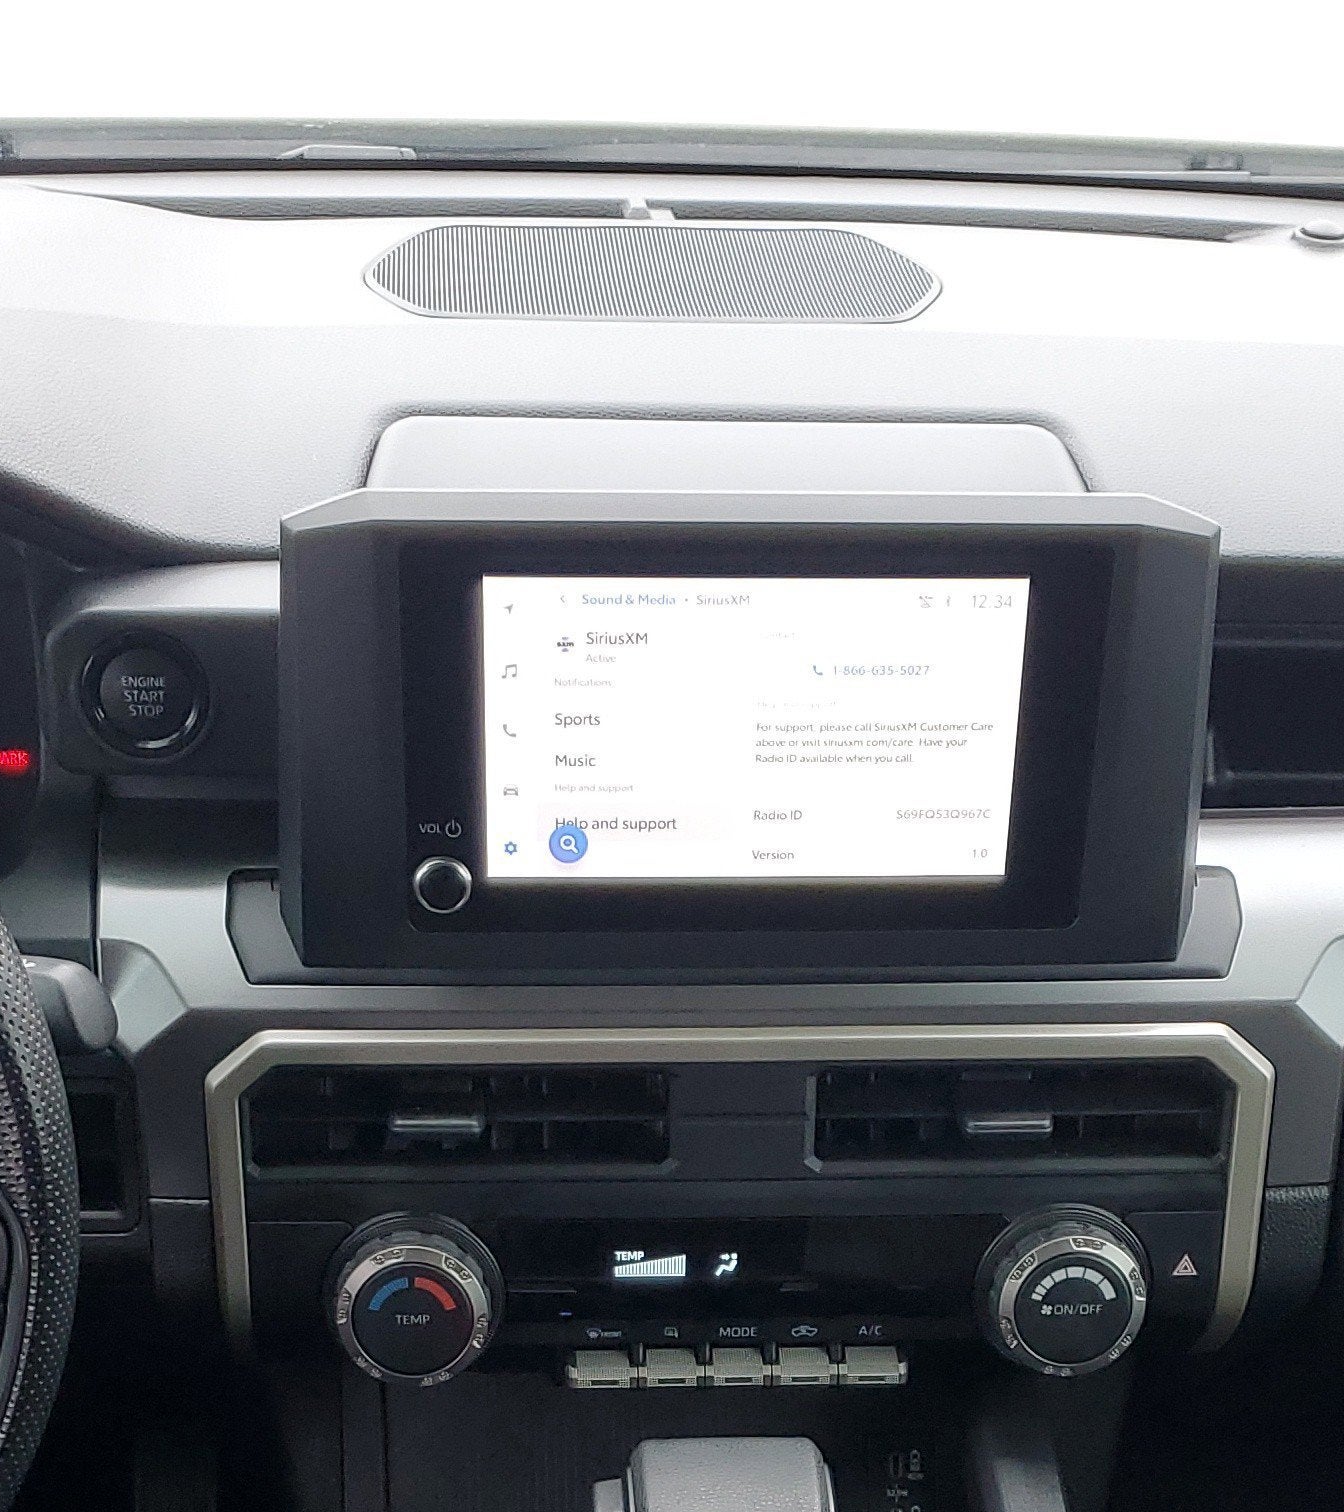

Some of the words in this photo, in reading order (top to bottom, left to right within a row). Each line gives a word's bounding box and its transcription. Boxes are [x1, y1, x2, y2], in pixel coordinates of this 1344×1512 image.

[582, 594, 622, 605] Sound
[625, 594, 634, 605] &
[638, 594, 676, 605] Media
[696, 594, 750, 606] SiriusXM
[586, 632, 648, 645] SiriusXM
[586, 653, 617, 662] Active
[833, 665, 931, 676] 1-866-635-5027
[121, 675, 166, 687] ENGINE
[554, 678, 613, 687] Notifications
[123, 690, 165, 702] START
[128, 704, 164, 717] STOP
[554, 713, 601, 728] Sports
[757, 723, 772, 732] For
[820, 723, 852, 734] please
[855, 722, 872, 732] call
[874, 723, 917, 732] SiriusXM
[920, 722, 968, 732] Customer
[971, 722, 994, 732] Care
[756, 738, 786, 747] above
[919, 738, 943, 747] Have
[945, 739, 968, 749] your
[555, 754, 596, 767] Music
[756, 754, 784, 763] Radio
[786, 754, 797, 763] ID
[800, 754, 843, 763] available
[846, 754, 872, 763] when
[874, 756, 893, 765] you
[554, 784, 576, 793] Help
[578, 784, 596, 792] and
[598, 785, 634, 794] support
[753, 809, 787, 820] Radio
[790, 809, 803, 820] ID
[592, 818, 618, 830] and
[622, 818, 677, 832] support
[752, 850, 795, 860] Version
[972, 848, 988, 859] 1.0
[614, 1250, 645, 1261] TEMP
[1054, 1304, 1104, 1315] ON/OFF
[395, 1314, 431, 1326] TEMP
[719, 1326, 758, 1338] MODE
[858, 1325, 883, 1336] A/C
